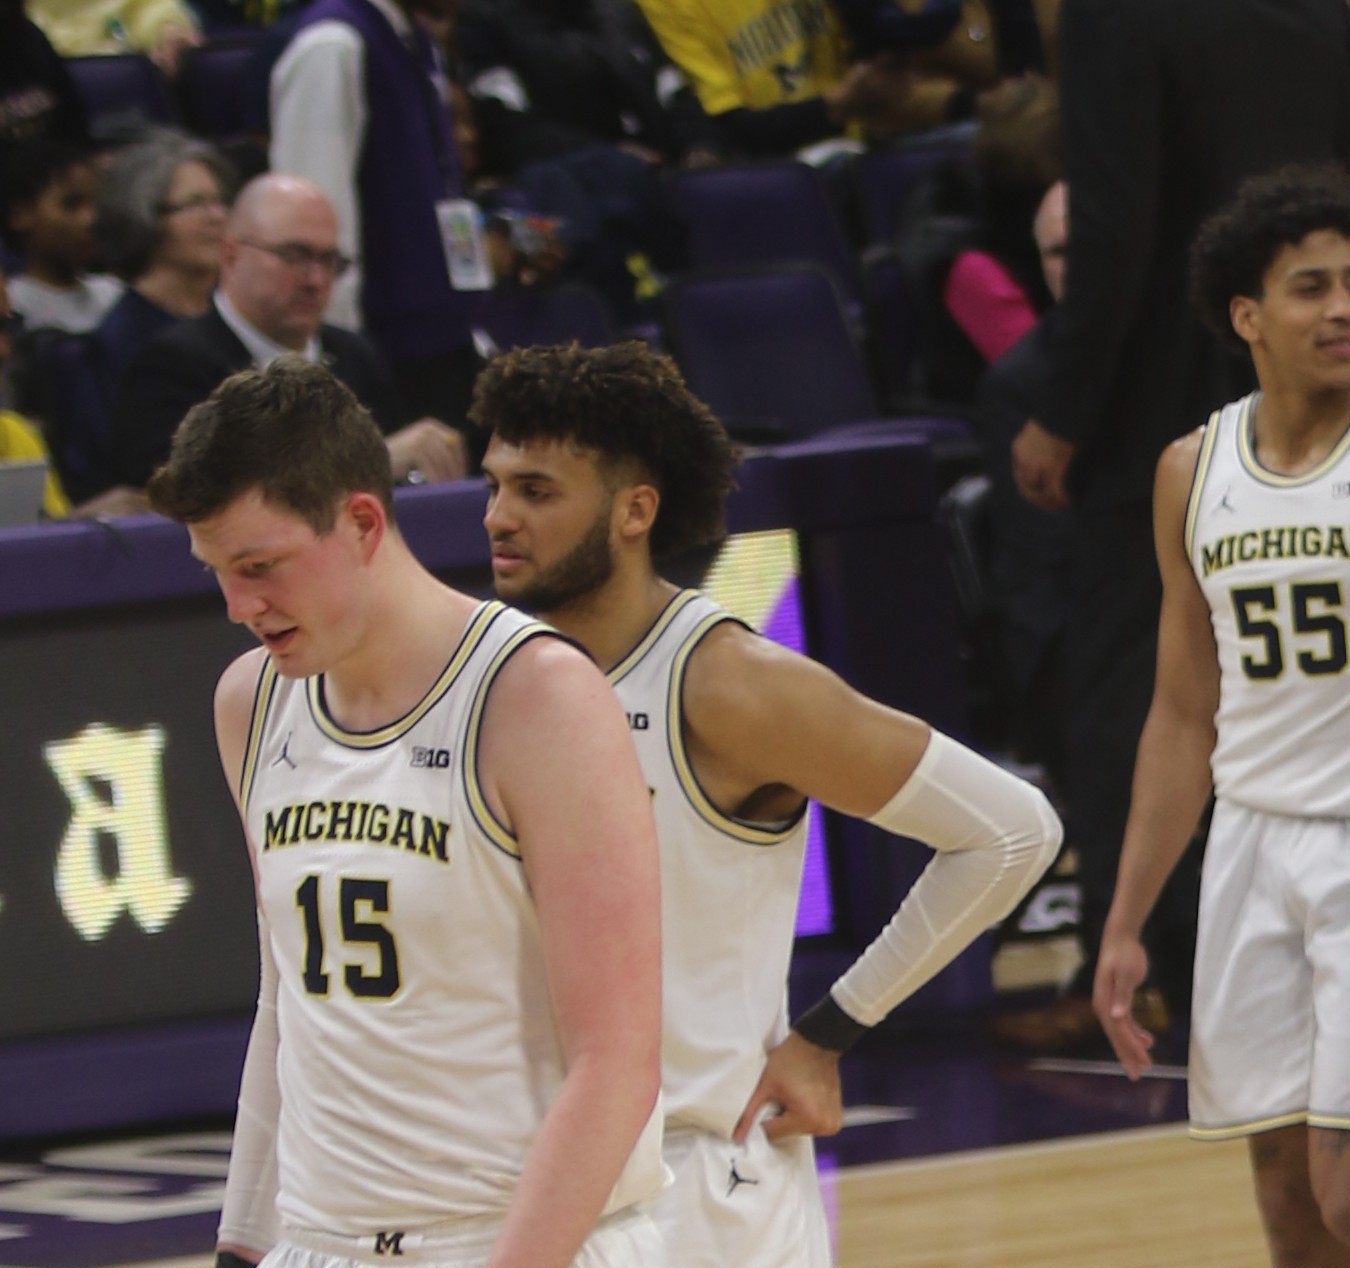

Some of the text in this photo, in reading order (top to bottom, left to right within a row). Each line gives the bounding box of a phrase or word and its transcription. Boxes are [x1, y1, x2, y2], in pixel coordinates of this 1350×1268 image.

[1228, 580, 1349, 682] 55
[263, 800, 451, 864] MICHIGAN
[296, 873, 402, 999] 15
[374, 1231, 405, 1256] M
